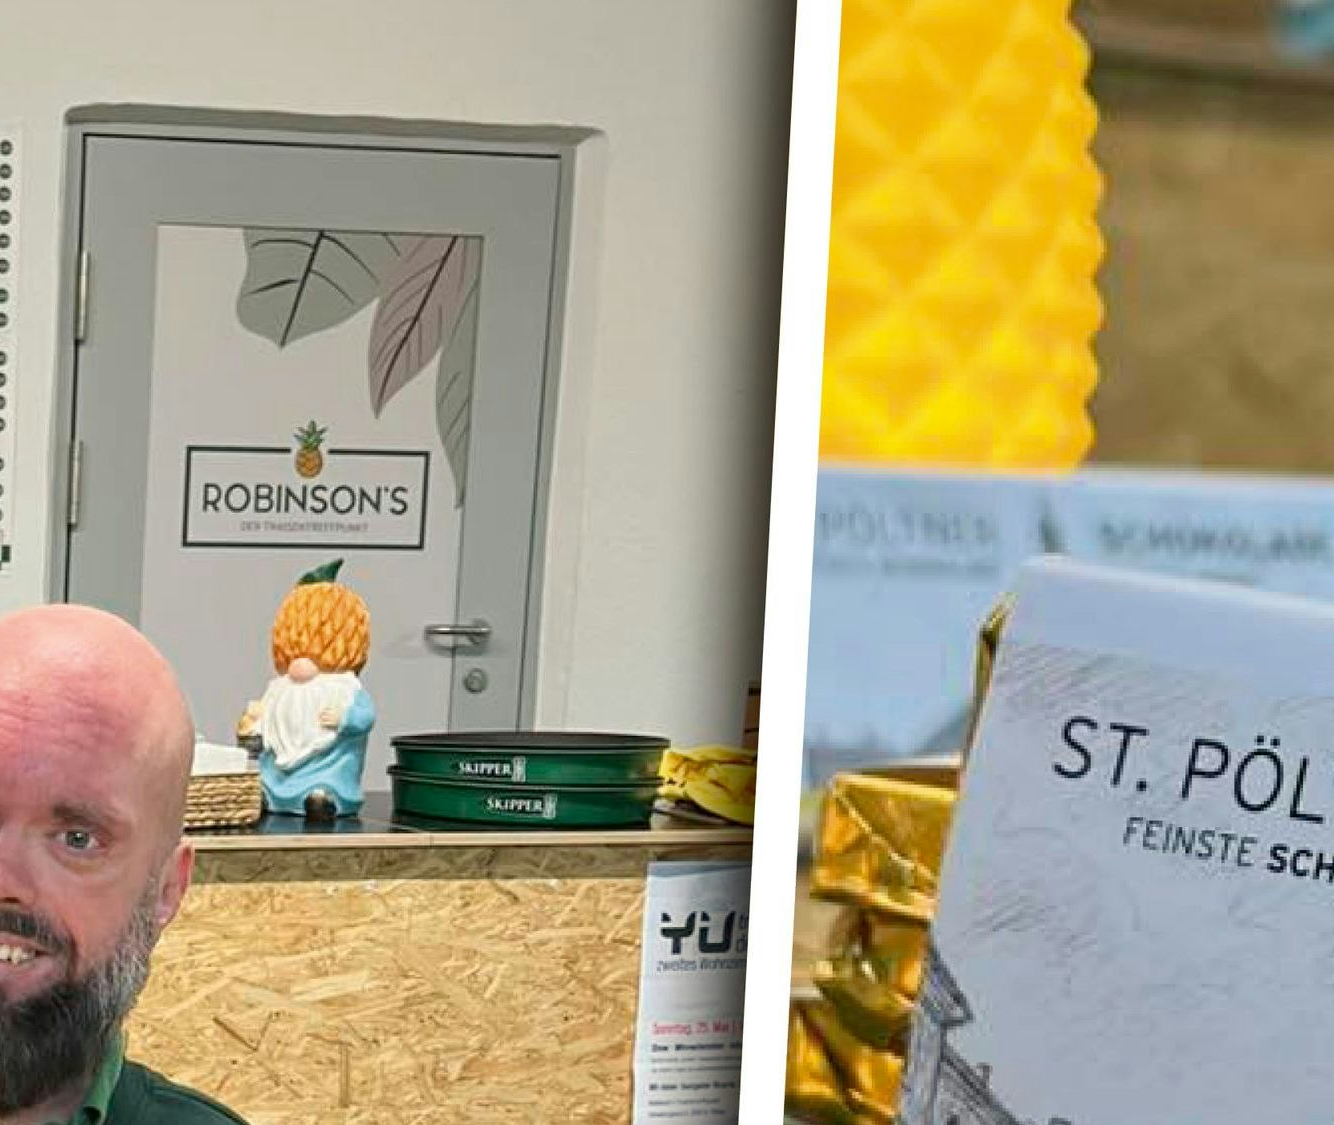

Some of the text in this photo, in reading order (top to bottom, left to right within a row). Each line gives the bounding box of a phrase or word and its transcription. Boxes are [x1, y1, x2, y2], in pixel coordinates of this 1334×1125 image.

[202, 482, 409, 515] ROBINSON'S
[457, 760, 512, 776] SKIPPER
[1052, 716, 1150, 792] ST.
[487, 797, 544, 812] SKIPPER
[1122, 816, 1258, 867] FEINSTE
